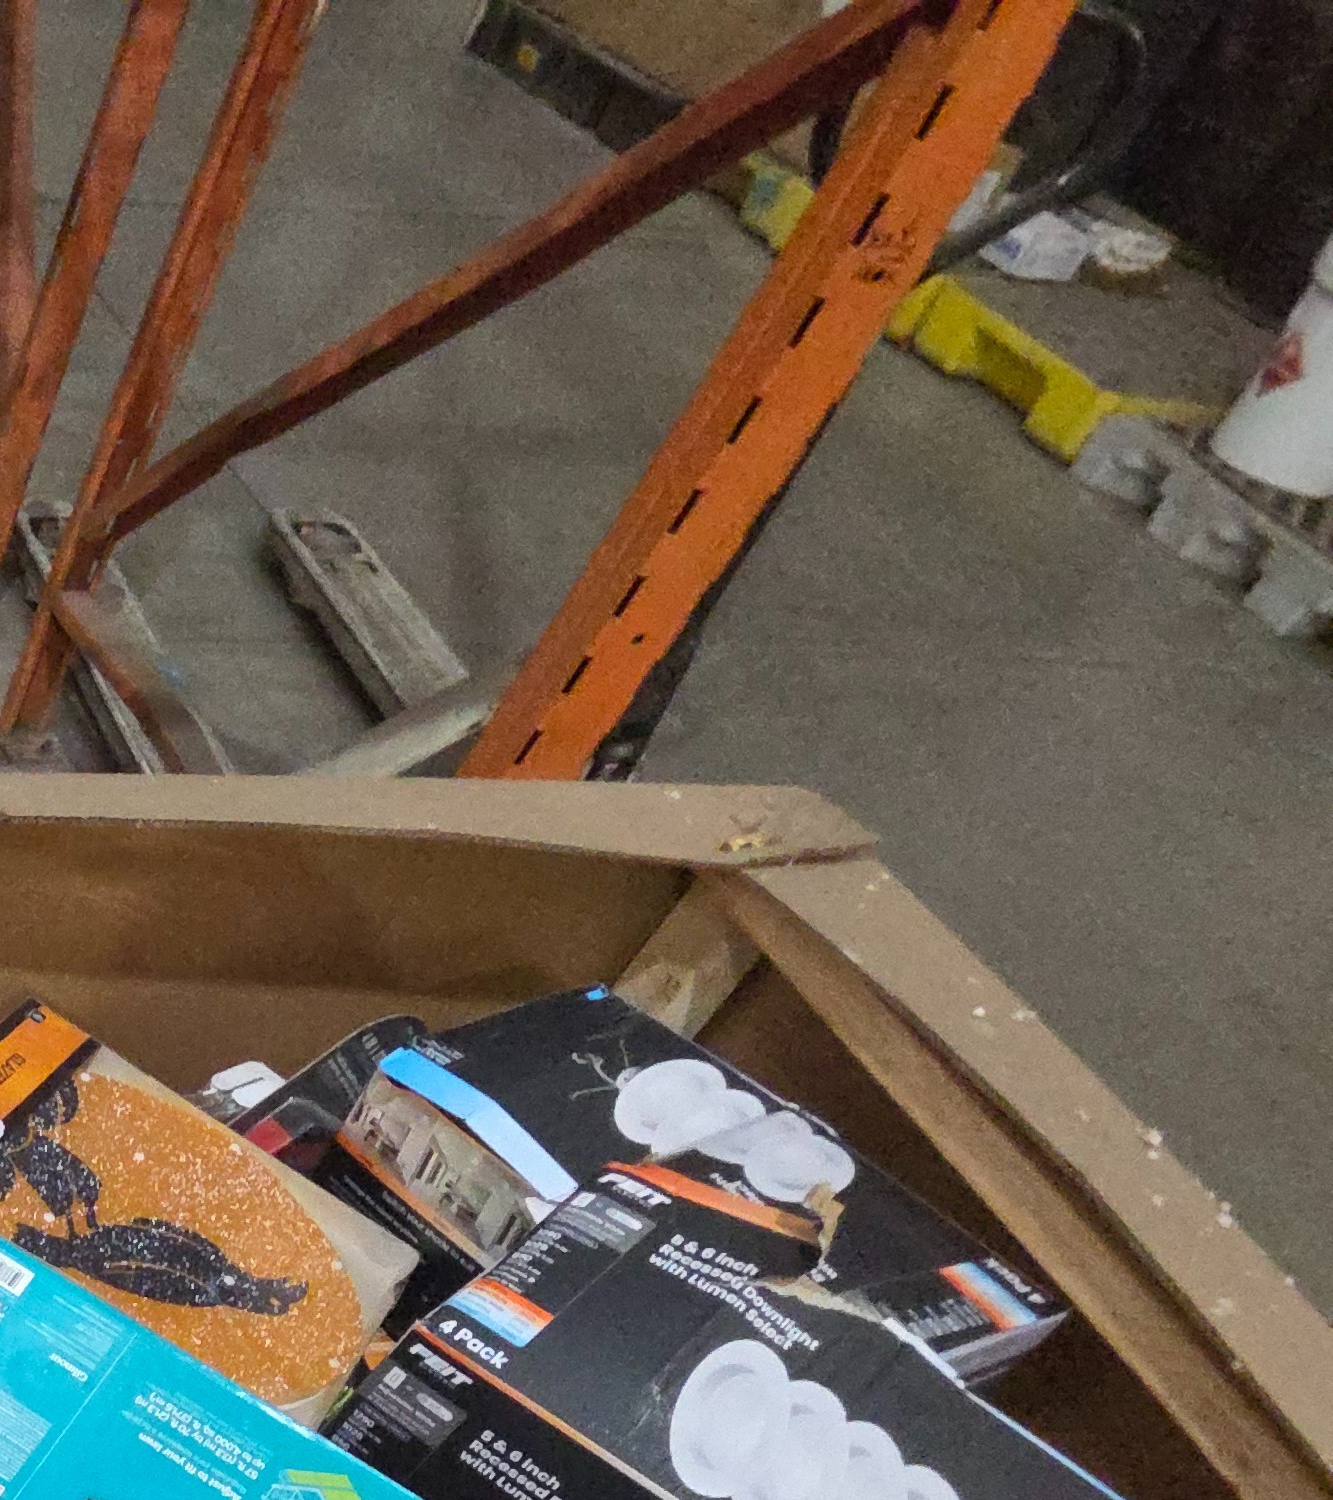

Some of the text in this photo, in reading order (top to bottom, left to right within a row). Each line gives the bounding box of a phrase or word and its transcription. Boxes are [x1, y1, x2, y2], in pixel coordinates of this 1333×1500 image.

[714, 1252, 760, 1277] Inch
[648, 1253, 794, 1351] with Lumen Select
[658, 1243, 820, 1352] Recessed Downlight
[409, 1342, 474, 1386] FEIT
[438, 1319, 510, 1370] 4 Pack
[48, 1352, 89, 1382] Gilmour
[160, 1445, 187, 1467] your
[195, 1468, 209, 1482] to
[459, 1449, 496, 1481] with
[468, 1439, 551, 1500] Recessed
[493, 1439, 509, 1455] &
[520, 1457, 561, 1491] Inch
